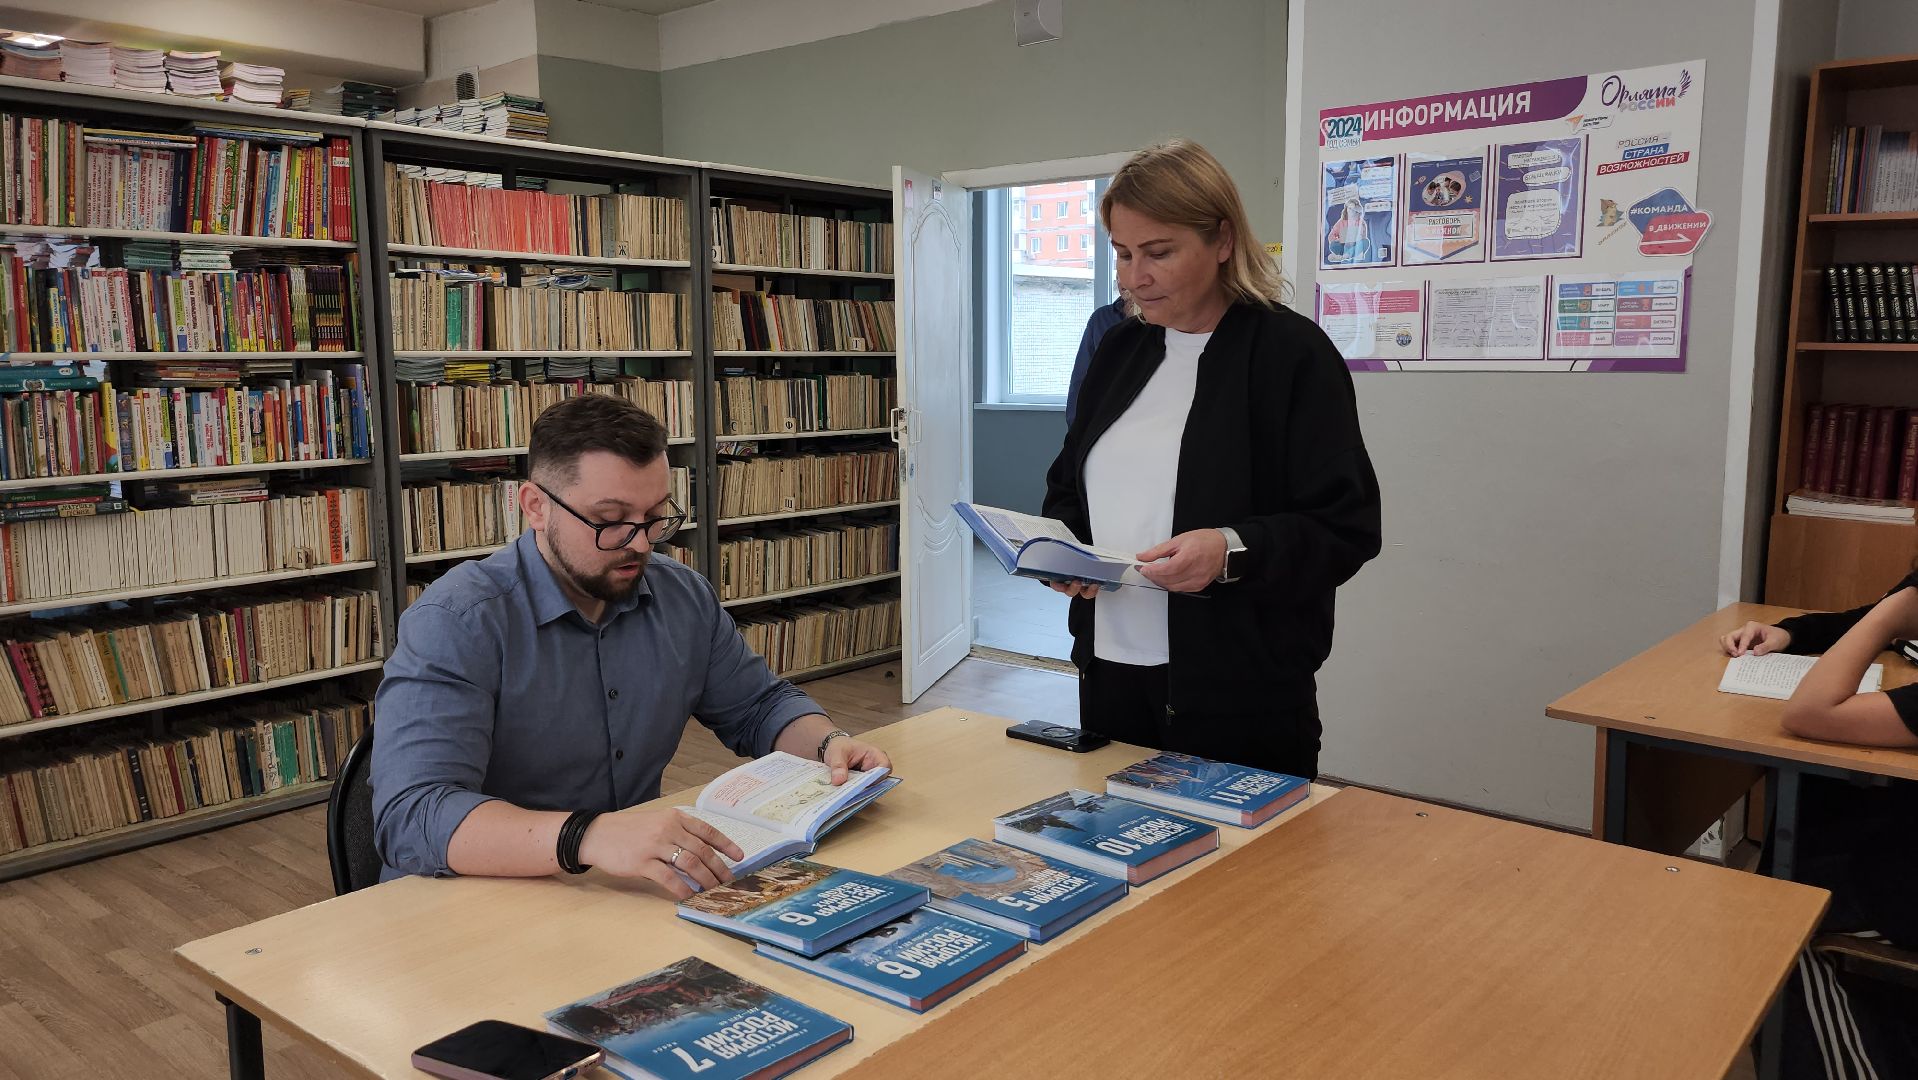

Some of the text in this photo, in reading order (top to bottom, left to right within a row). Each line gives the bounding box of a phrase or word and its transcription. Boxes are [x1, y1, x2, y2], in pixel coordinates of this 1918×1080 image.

[1601, 75, 1677, 108] Орлята
[1364, 90, 1531, 132] ИНФОРМАЦИЯ
[1619, 97, 1676, 112] РОССИИ
[1327, 116, 1362, 139] 2024
[1617, 135, 1659, 149] РОССИЯ
[1624, 146, 1665, 160] СТРАНА
[1599, 152, 1685, 174] ВОЗМОЖНОСТЕЙ
[1630, 203, 1689, 216] #КОМАНДА
[618, 244, 627, 256] Ж
[1209, 791, 1251, 804] 11
[1118, 818, 1172, 840] РОССИИ
[1135, 822, 1189, 846] ИСТОРИЯ
[1095, 838, 1142, 856] 10
[816, 881, 860, 898] ВЕКОВ
[1022, 871, 1071, 896] ДРЕВНЕГО
[1029, 876, 1089, 904] ИСТОРИЯ
[811, 884, 870, 907] СРЕДНИХ
[812, 887, 886, 917] ИСТОРИЯ
[997, 896, 1041, 912] 5
[777, 911, 818, 926] 6
[896, 928, 965, 963] РОССИИ
[915, 934, 983, 969] ИСТОРИЯ
[876, 960, 922, 980] 6
[693, 1010, 782, 1052] РОССИИ
[712, 1019, 799, 1060] ИСТОРИЯ
[671, 1046, 717, 1073] 7
